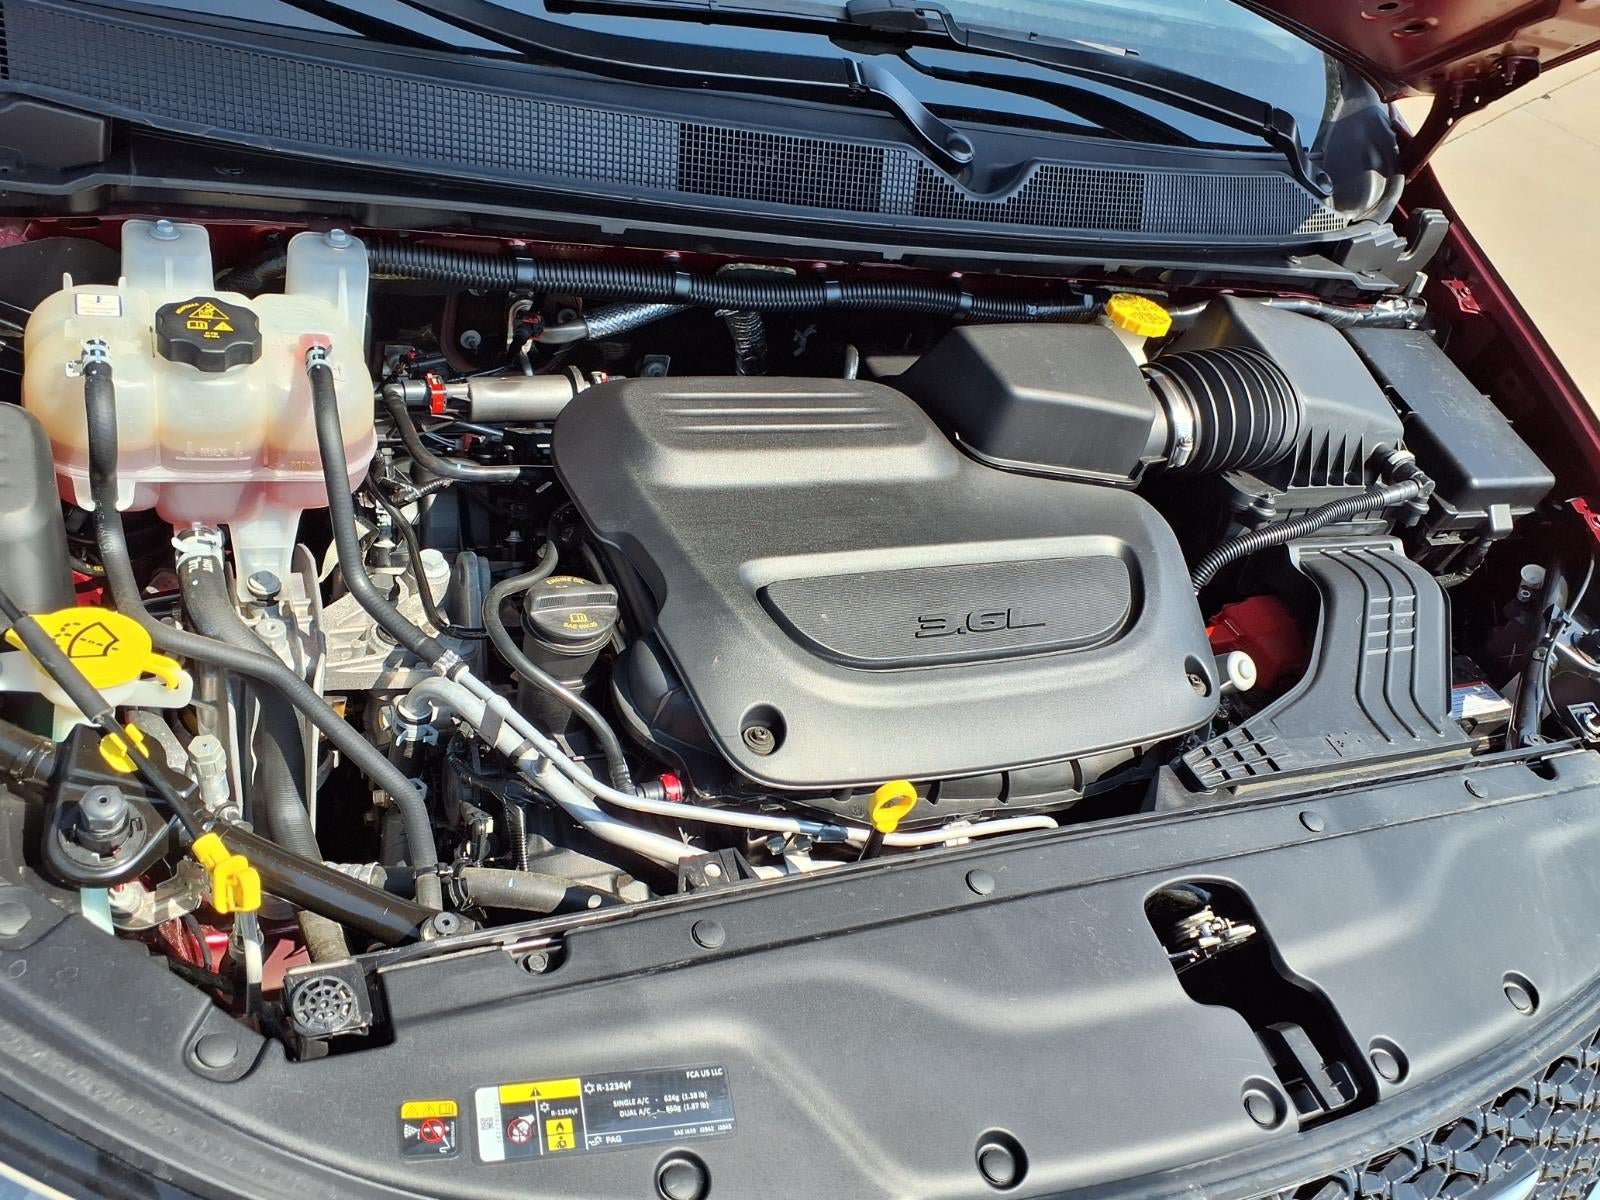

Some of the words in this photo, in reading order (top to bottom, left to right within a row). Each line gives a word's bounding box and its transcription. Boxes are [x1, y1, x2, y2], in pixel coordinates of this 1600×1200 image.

[546, 577, 572, 585] ENGINE
[573, 577, 585, 585] OIL
[915, 607, 1046, 639] 3.6L
[686, 1070, 700, 1080] FCA
[701, 1069, 711, 1078] US
[712, 1067, 723, 1076] LLC
[596, 1080, 632, 1092] R-1234yf
[613, 1099, 636, 1108] SINGLE
[637, 1097, 650, 1106] A/C
[698, 1090, 708, 1100] lb)
[619, 1110, 637, 1118] DUAL
[638, 1108, 651, 1117] A/C
[605, 1135, 623, 1145] PAG
